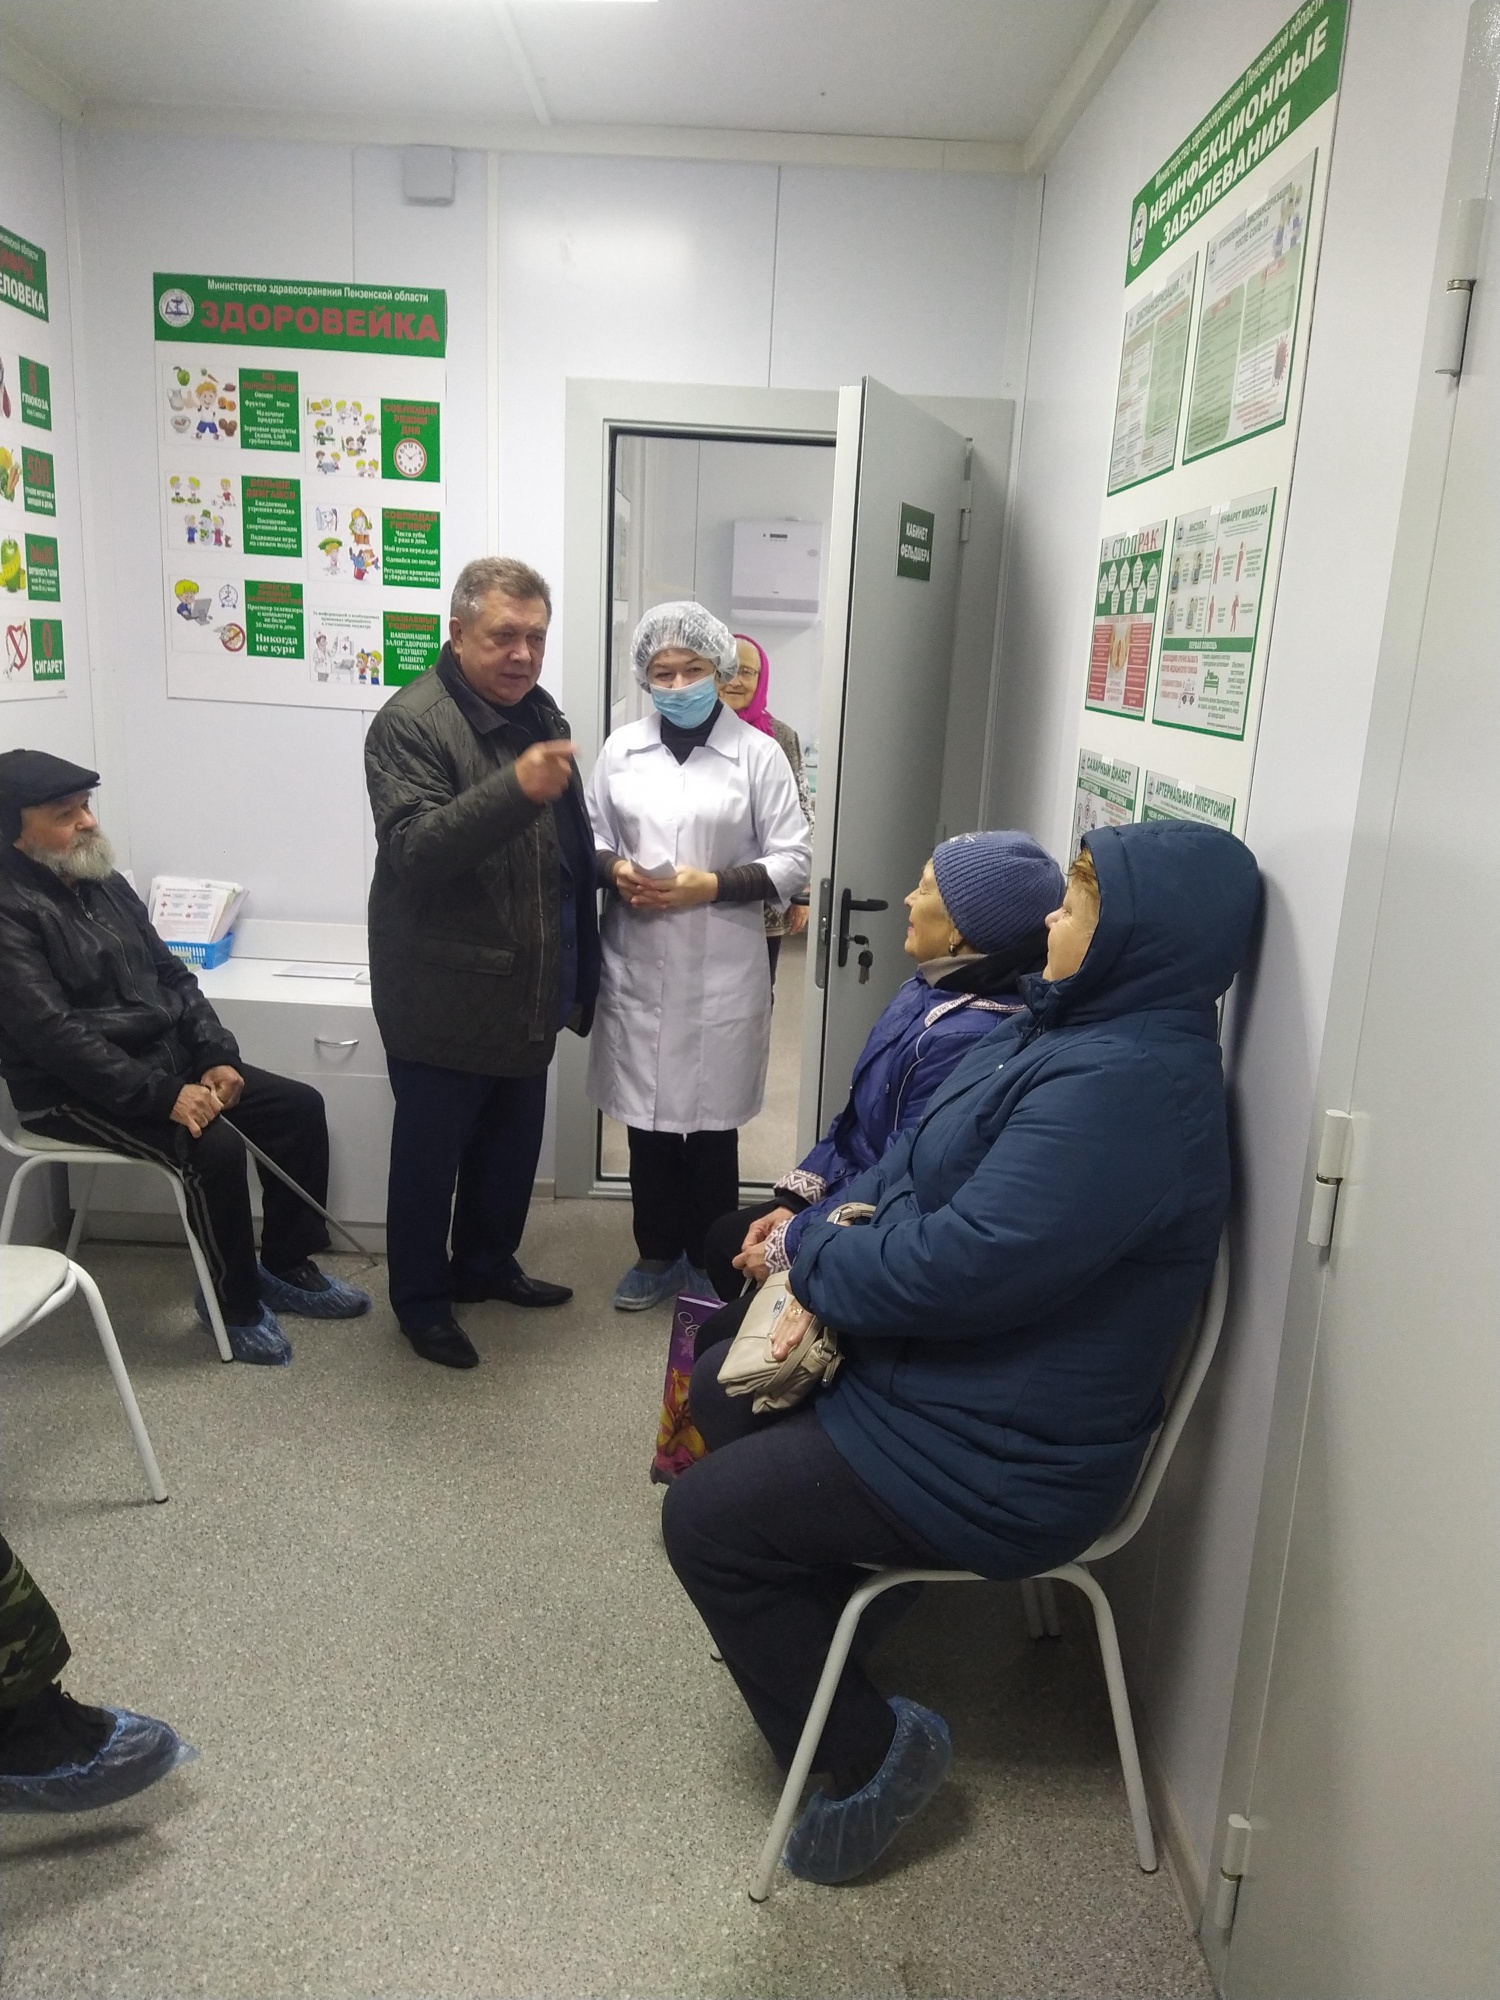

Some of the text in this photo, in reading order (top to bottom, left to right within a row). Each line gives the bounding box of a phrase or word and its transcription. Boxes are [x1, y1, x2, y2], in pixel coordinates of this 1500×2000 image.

[1148, 16, 1329, 229] НЕИНФЕКЦИОННЫЕ
[1161, 100, 1291, 248] ЗАБОЛЕВАНИЯ
[207, 278, 429, 303] Министерство здравоохранения Пензенской области
[200, 300, 440, 342] ЗДОРОВЕЙКА
[383, 403, 438, 415] СОБЛЮДАЙ
[393, 414, 428, 425] РЕЖИМ
[401, 425, 421, 436] ДНЯ
[27, 454, 49, 487] 500
[383, 510, 438, 522] СОБЛЮДАЙ
[389, 521, 431, 532] ГИГИЕНУ
[905, 521, 928, 541] КАБИНЕТ
[412, 531, 426, 539] зубы
[414, 538, 428, 546] день
[409, 547, 425, 555] перед
[255, 632, 298, 646] Никогда
[390, 631, 430, 640] ВАКЦИНАЦИЯ
[256, 643, 296, 656] не кури
[404, 640, 439, 649] ЗДОРОВОГО
[396, 647, 428, 656] БУДУЩЕГО
[400, 655, 424, 664] ВАШЕГО
[34, 658, 63, 675] СИГАРЕТ
[1087, 756, 1111, 780] САХАРНЫЙ
[1110, 766, 1132, 785] ДИАБЕТ
[1155, 781, 1193, 809] АРТЕРИАЛЬНАЯ
[1193, 794, 1231, 822] ГИПЕРТОНИЯ
